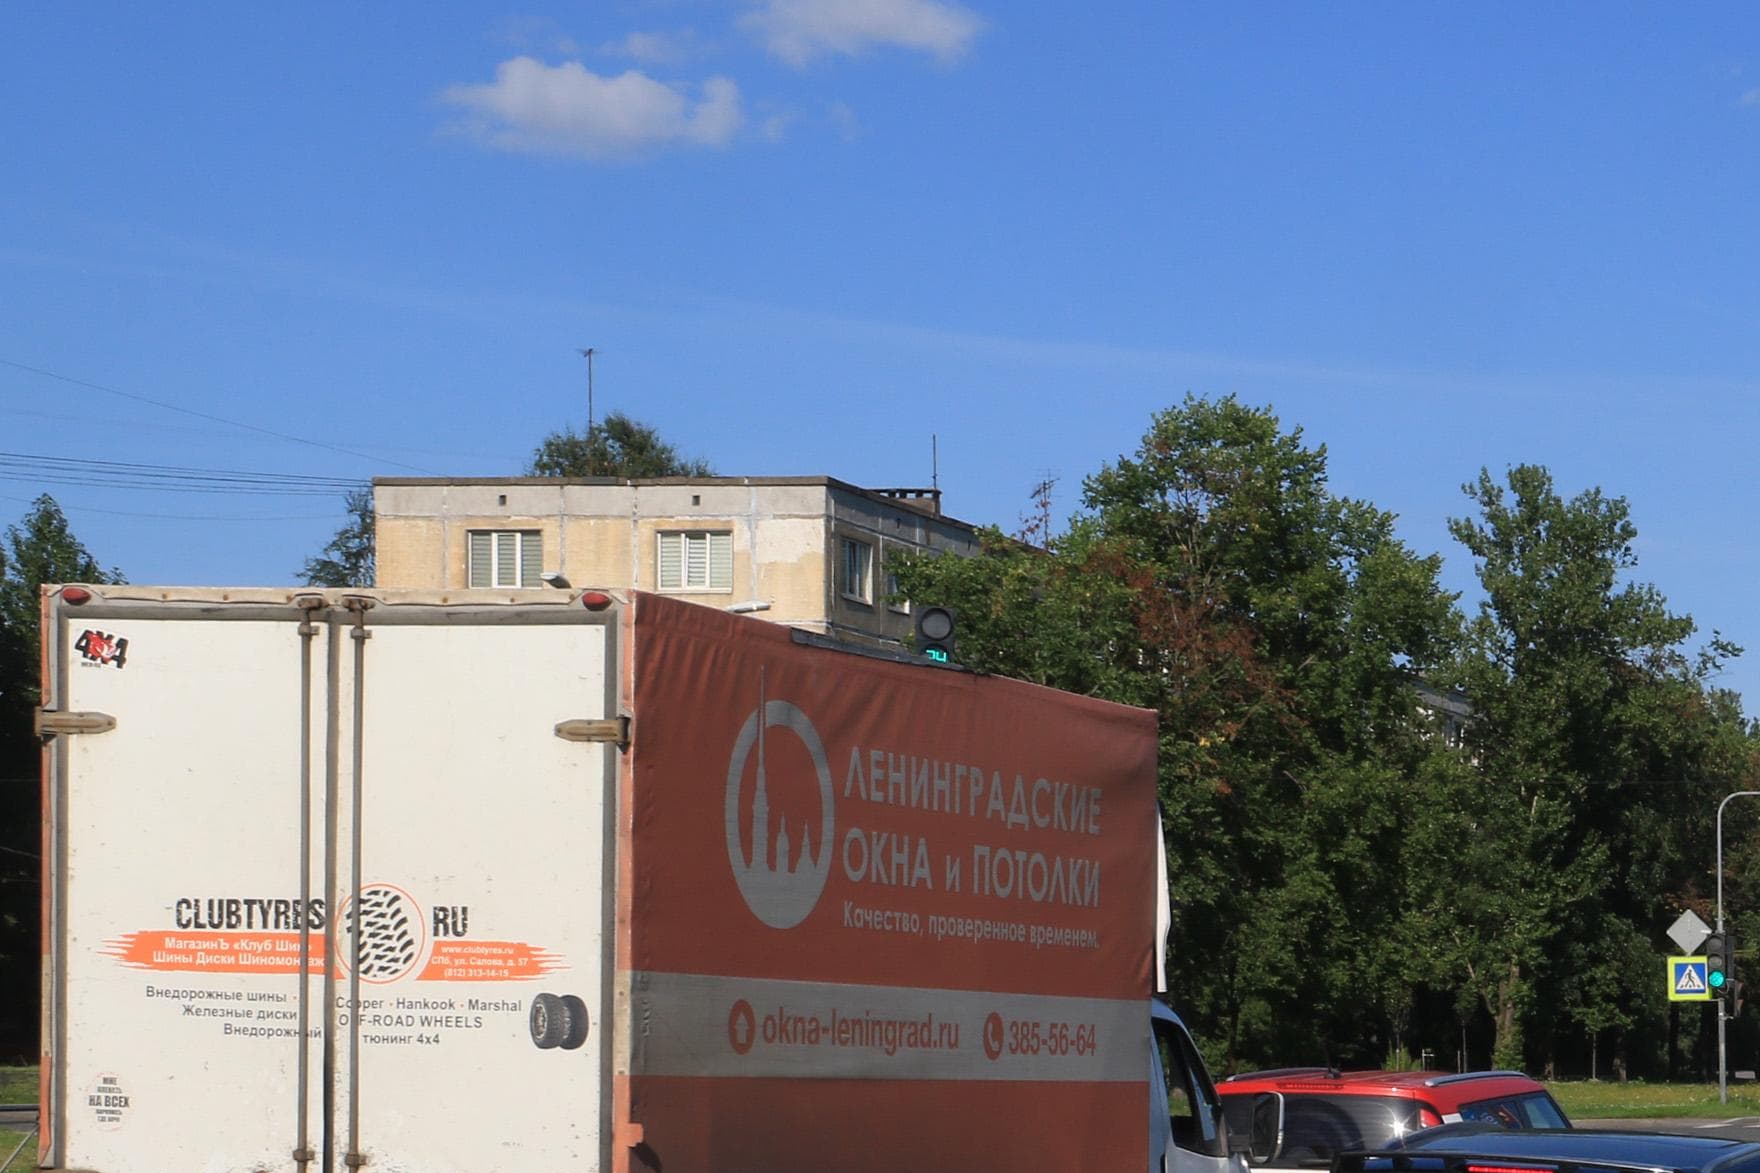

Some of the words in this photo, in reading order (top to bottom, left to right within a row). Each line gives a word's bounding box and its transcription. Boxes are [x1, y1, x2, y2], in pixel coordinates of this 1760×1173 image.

[844, 745, 1101, 834] ЛЕНИНГРАДСКИЕ
[842, 827, 933, 889] ОКНА
[945, 855, 961, 893] и
[973, 844, 1101, 908] ПОТОЛКИ
[175, 898, 326, 930] CLUBTYRES
[432, 906, 469, 937] RU
[843, 901, 924, 936] Качество,
[928, 914, 1026, 944] проверенное
[1030, 924, 1101, 950] временем.
[153, 952, 192, 963] Шины
[196, 953, 235, 965] Диски
[238, 954, 325, 967] Шиномонаж
[164, 937, 229, 949] МагазинЪ
[233, 939, 272, 951] «Клуб
[275, 940, 312, 951] Ши»
[146, 985, 243, 1000] Внедорожные
[247, 991, 287, 1003] шины
[396, 998, 455, 1010] Hankook
[468, 998, 521, 1011] Marshal
[182, 1005, 253, 1019] Железные
[257, 1008, 297, 1021] диски
[339, 1014, 415, 1027] OF-ROAD
[420, 1015, 483, 1028] WHEELS
[762, 1006, 959, 1056] okna-leningrad.ru
[1008, 1020, 1096, 1056] 385-56-64
[362, 1034, 411, 1046] тюнинг
